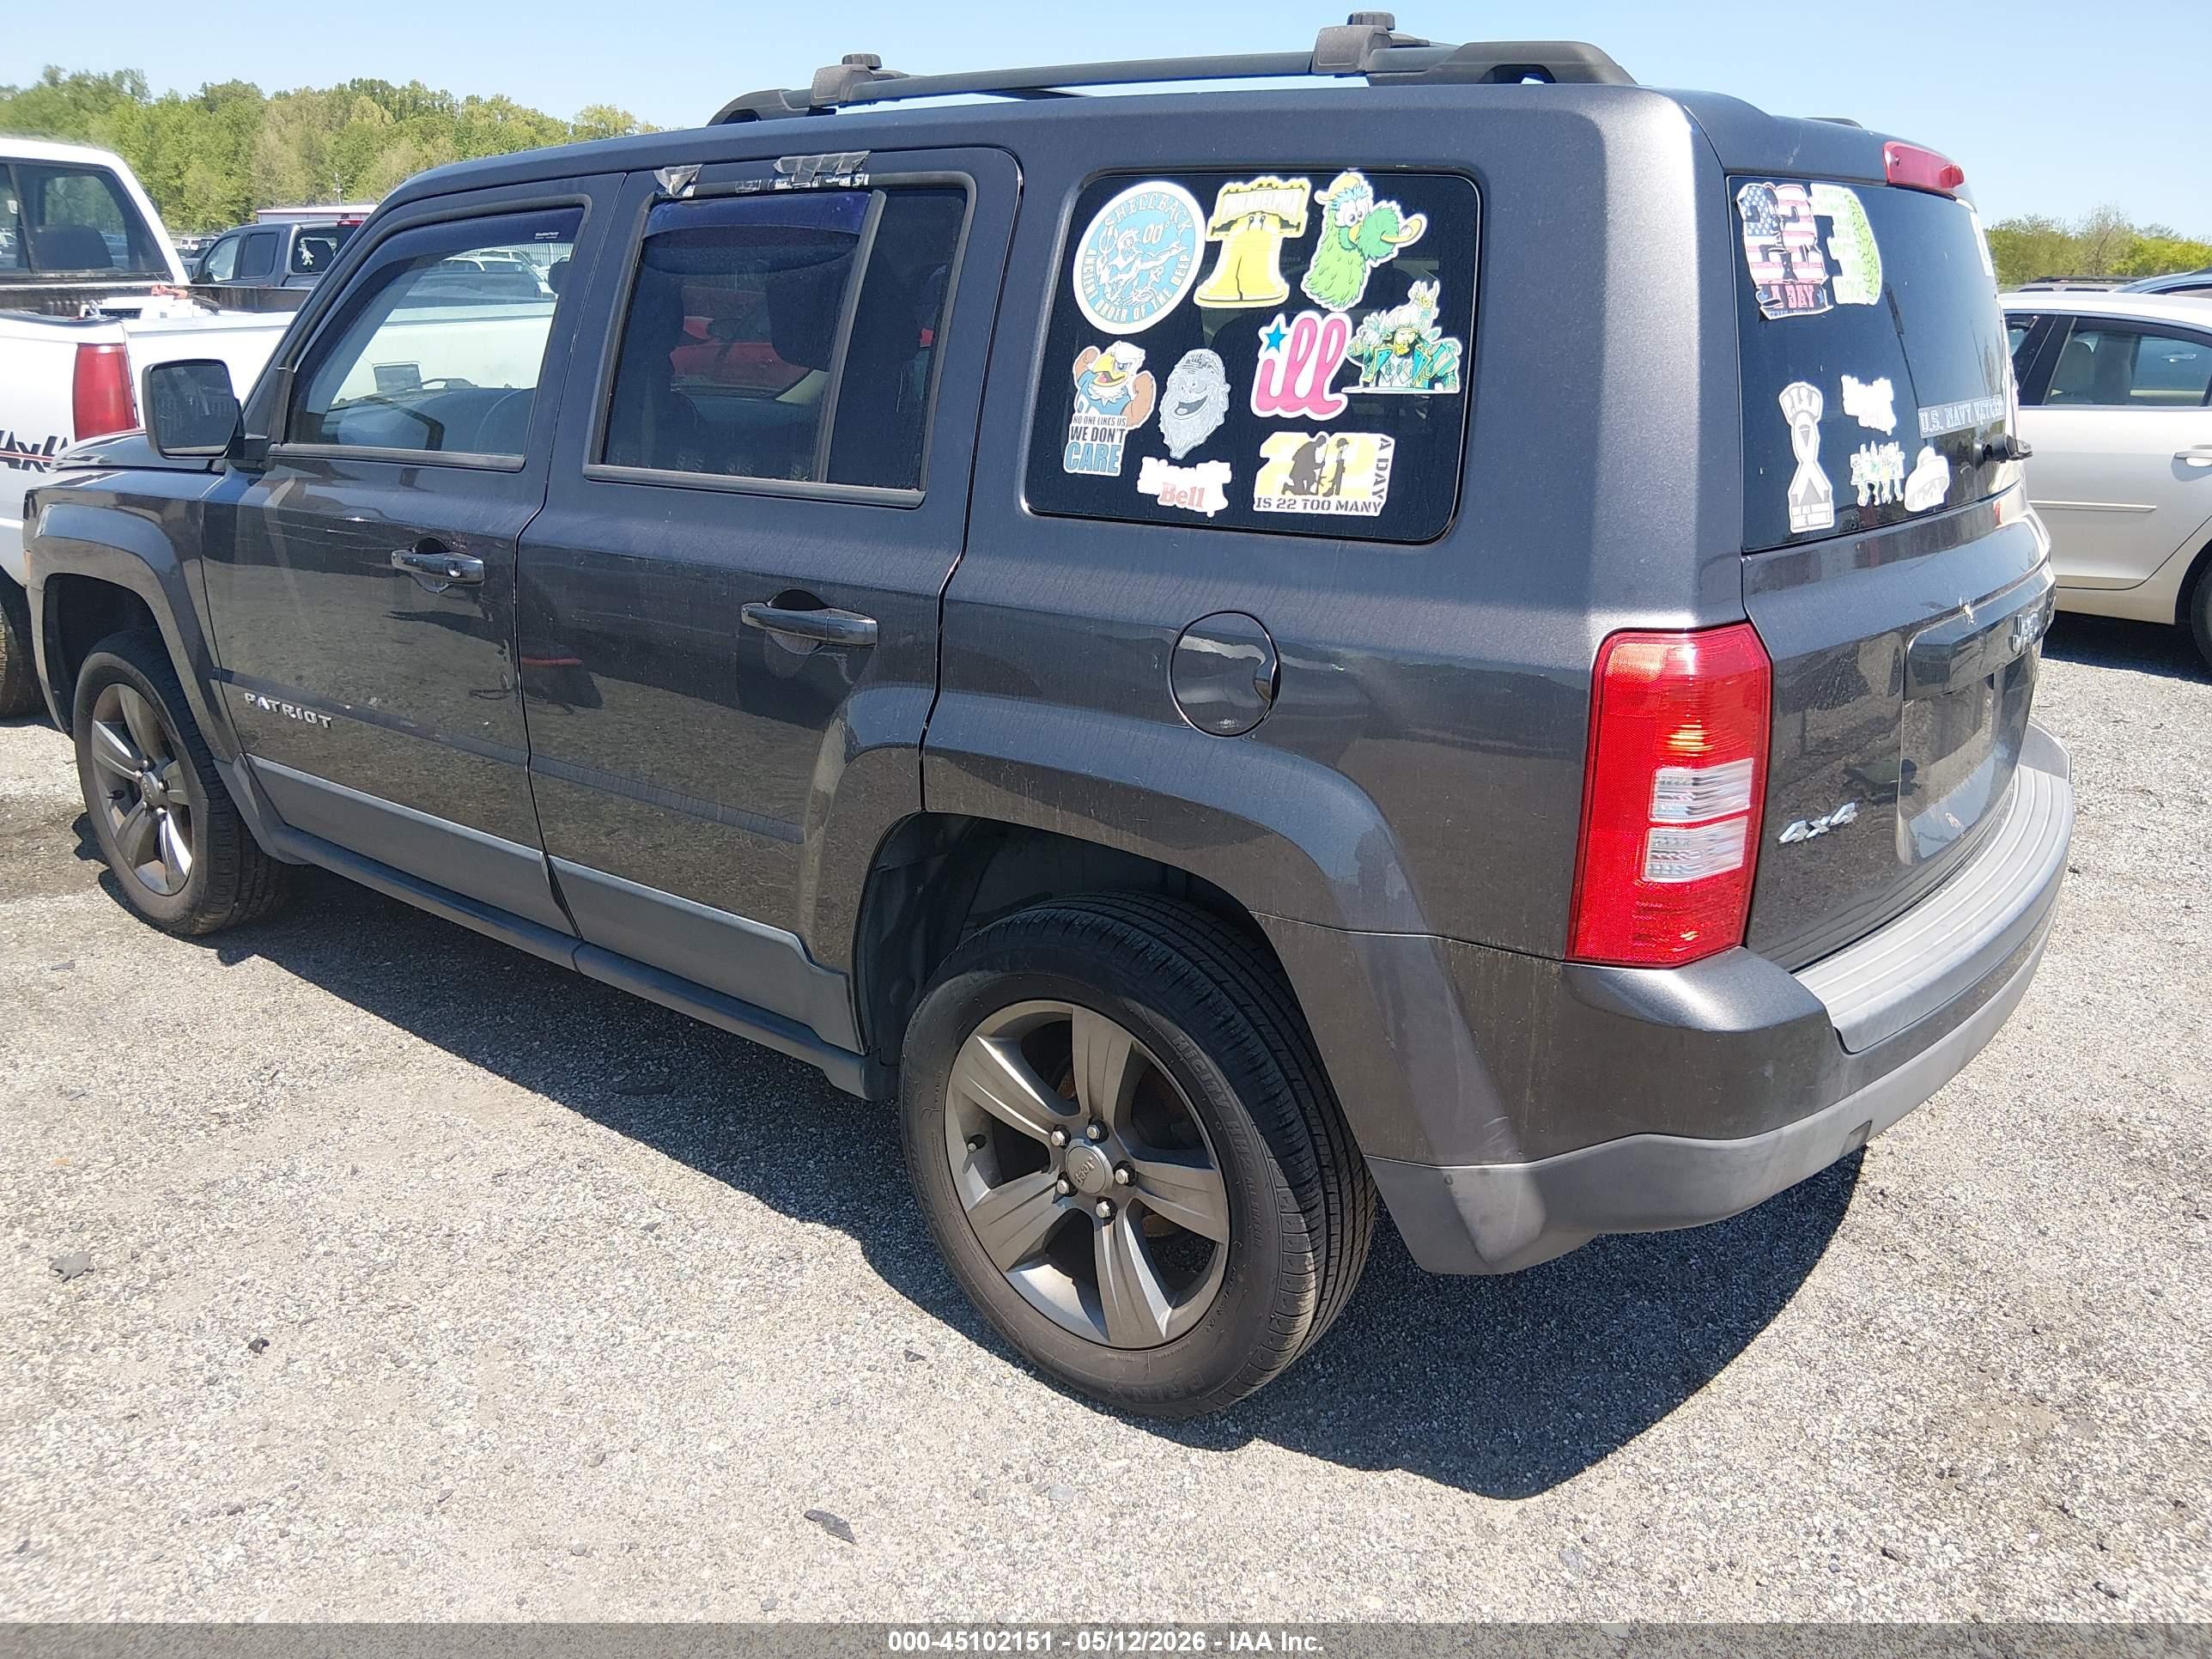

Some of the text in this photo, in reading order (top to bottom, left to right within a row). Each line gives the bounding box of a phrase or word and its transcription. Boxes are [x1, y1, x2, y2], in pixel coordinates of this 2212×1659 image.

[1104, 191, 1195, 237] SHELLBACK
[1094, 300, 1128, 323] ORDER
[1133, 304, 1147, 321] OF
[1151, 288, 1174, 311] THE
[1170, 253, 1192, 288] DEEP
[1256, 317, 1346, 415] ill
[1073, 416, 1127, 427] NO ONE LIKES US
[1918, 410, 1944, 434] U.S.
[1943, 403, 1972, 428] NAVY
[1070, 426, 1126, 443] WE DON'T
[1065, 441, 1121, 473] CARE
[1372, 437, 1392, 500] A DAY
[1159, 482, 1206, 508] Bell
[1256, 496, 1382, 514] IS 22 TOO MANY
[244, 692, 331, 728] PATRIOT
[1074, 1156, 1096, 1185] Jeep
